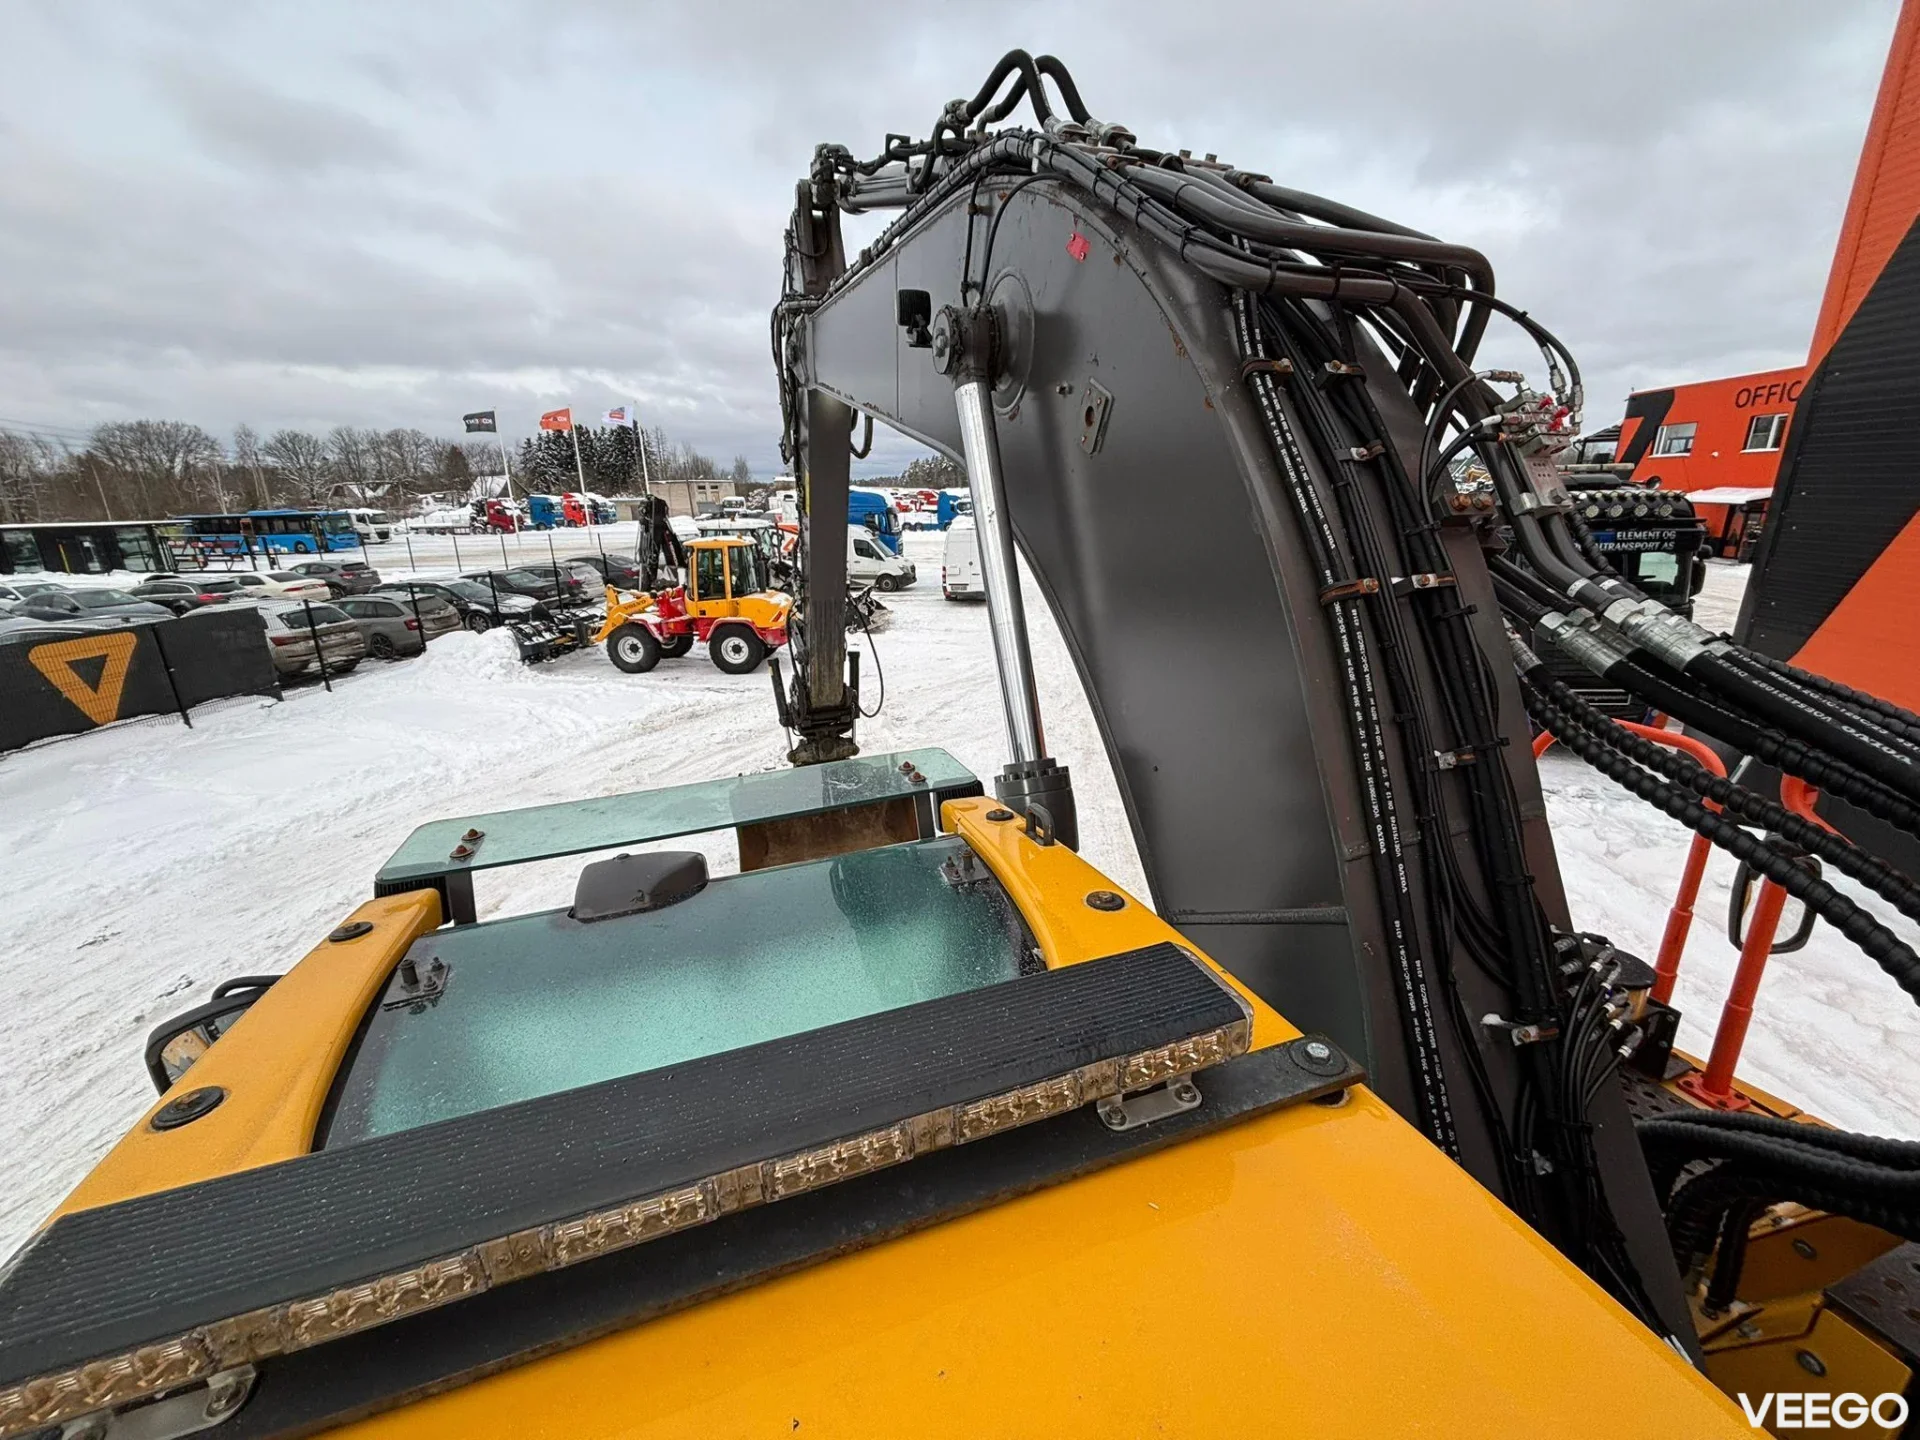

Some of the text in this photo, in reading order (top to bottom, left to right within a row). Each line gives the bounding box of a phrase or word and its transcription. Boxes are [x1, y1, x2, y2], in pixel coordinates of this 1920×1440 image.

[1296, 487, 1308, 513] VOLVO
[1323, 524, 1335, 549] VOLVO
[1616, 530, 1677, 540] ELEMENT OG
[1594, 541, 1675, 551] LTRANSPORT AS
[624, 600, 646, 610] VOLVO
[1341, 635, 1350, 653] MSHA
[1729, 666, 1749, 678] DN
[1356, 711, 1363, 722] WP
[1768, 670, 1803, 690] MSHA
[1896, 737, 1920, 754] 431
[1841, 726, 1912, 765] VOLVO
[1376, 824, 1386, 854] VOLVO
[1398, 863, 1407, 893] VOLVO
[1424, 1074, 1431, 1086] WP
